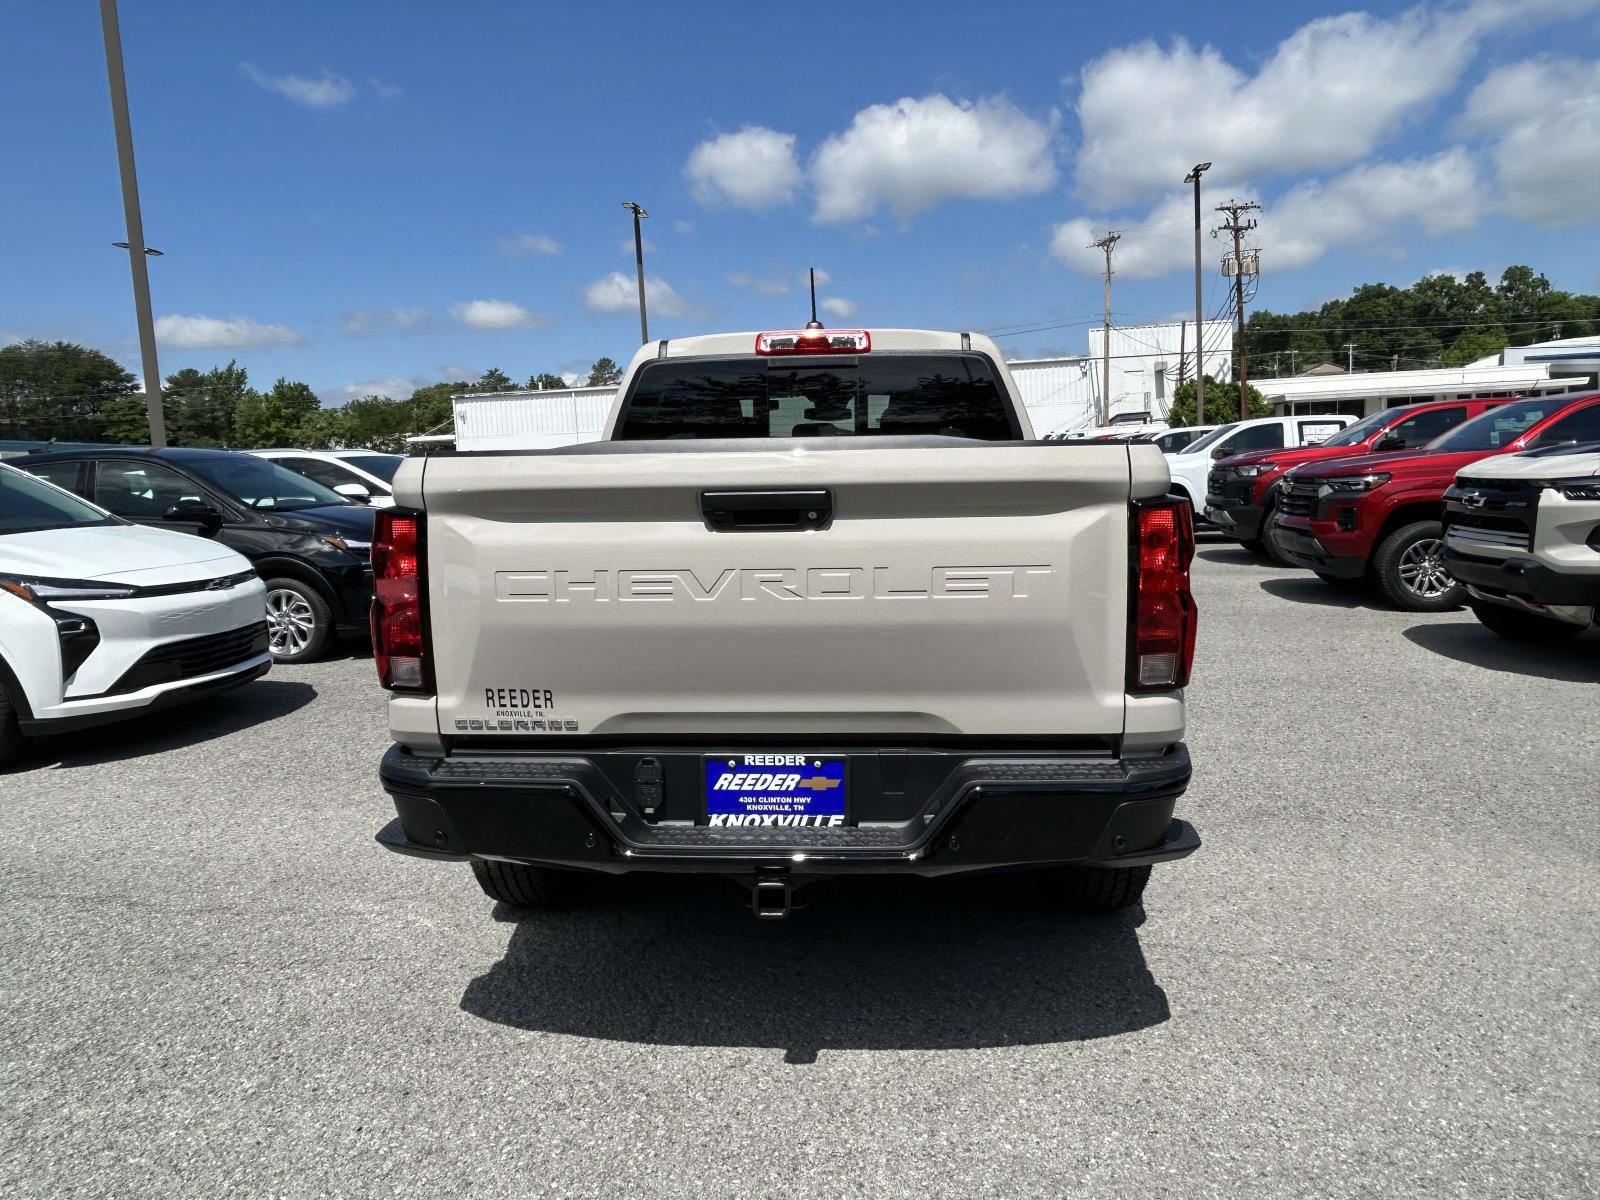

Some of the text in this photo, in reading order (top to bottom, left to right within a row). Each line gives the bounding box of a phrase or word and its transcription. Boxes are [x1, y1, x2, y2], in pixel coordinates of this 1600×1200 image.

[495, 564, 1054, 603] CHEVROLET
[485, 688, 554, 708] REEDER
[496, 710, 534, 718] KNOXVILLE,
[455, 719, 579, 732] COLORADO
[744, 755, 806, 766] REEDER
[713, 773, 801, 791] REEDER
